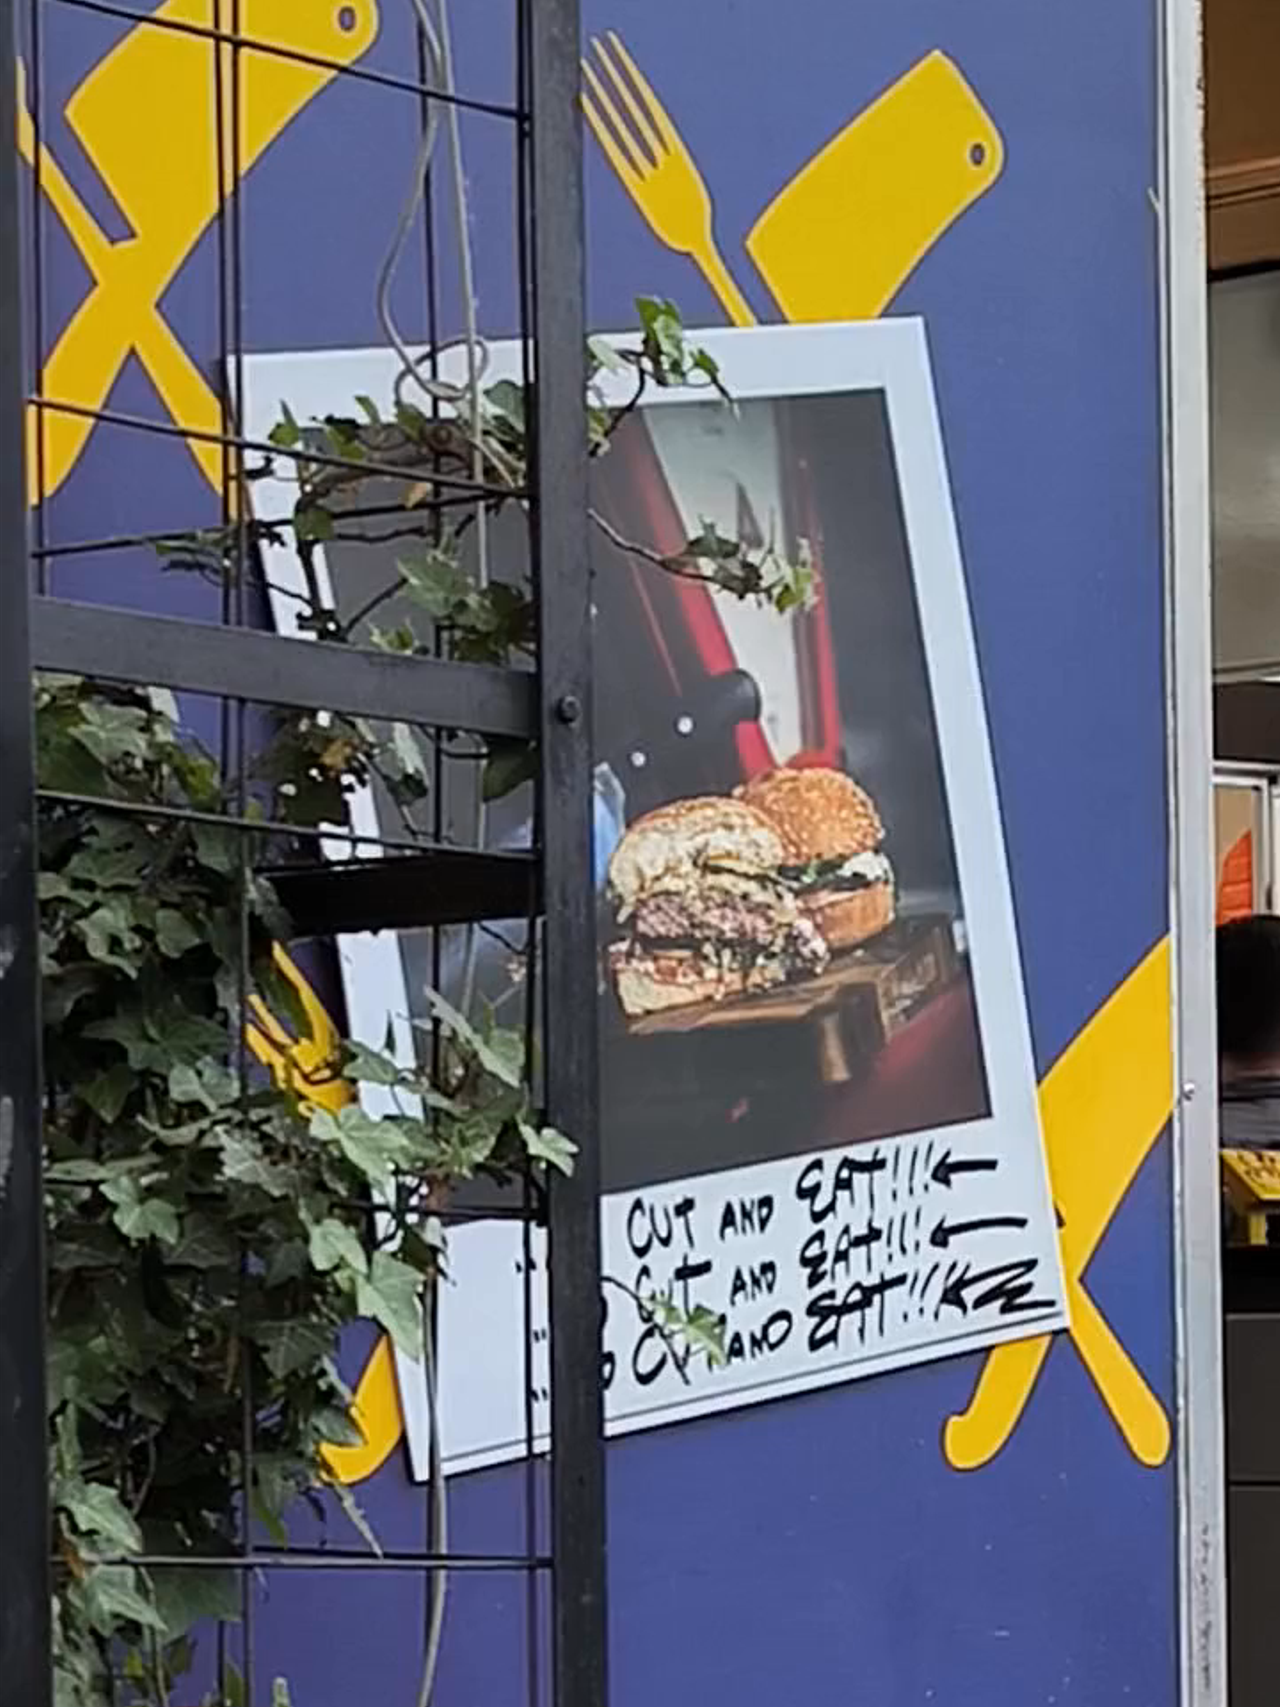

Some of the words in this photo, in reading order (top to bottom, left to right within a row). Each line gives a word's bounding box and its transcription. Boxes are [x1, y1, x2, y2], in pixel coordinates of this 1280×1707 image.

[627, 1196, 696, 1259] CUT
[719, 1194, 774, 1242] AND
[729, 1261, 778, 1306] AND
[726, 1309, 794, 1364] AND
